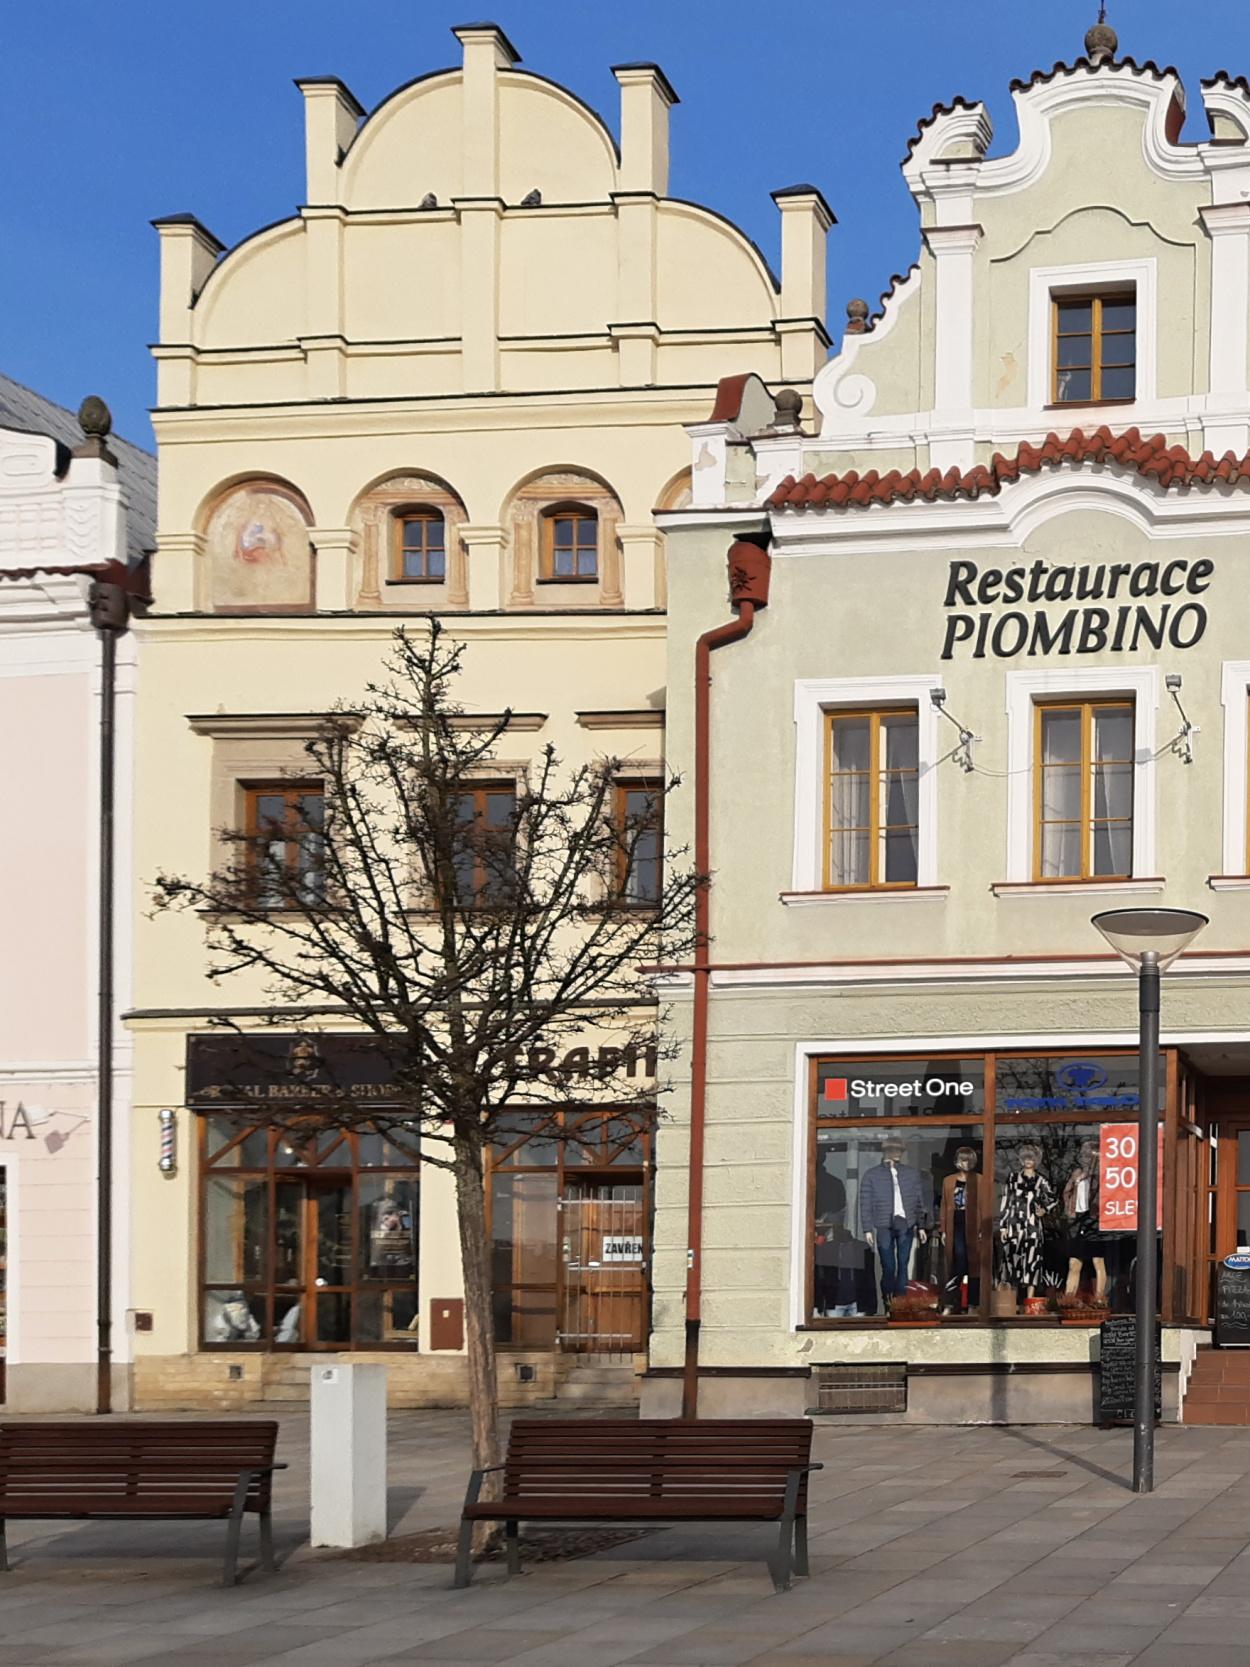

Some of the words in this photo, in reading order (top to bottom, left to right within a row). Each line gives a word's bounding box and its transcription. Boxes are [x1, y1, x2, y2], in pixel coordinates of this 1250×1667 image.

[944, 558, 1214, 607] Restaurace
[941, 602, 1207, 659] PIOMBINO
[850, 1079, 922, 1098] Street
[926, 1078, 974, 1097] One
[1105, 1136, 1137, 1158] 30
[1105, 1166, 1137, 1189] 50
[1104, 1200, 1138, 1216] SLE
